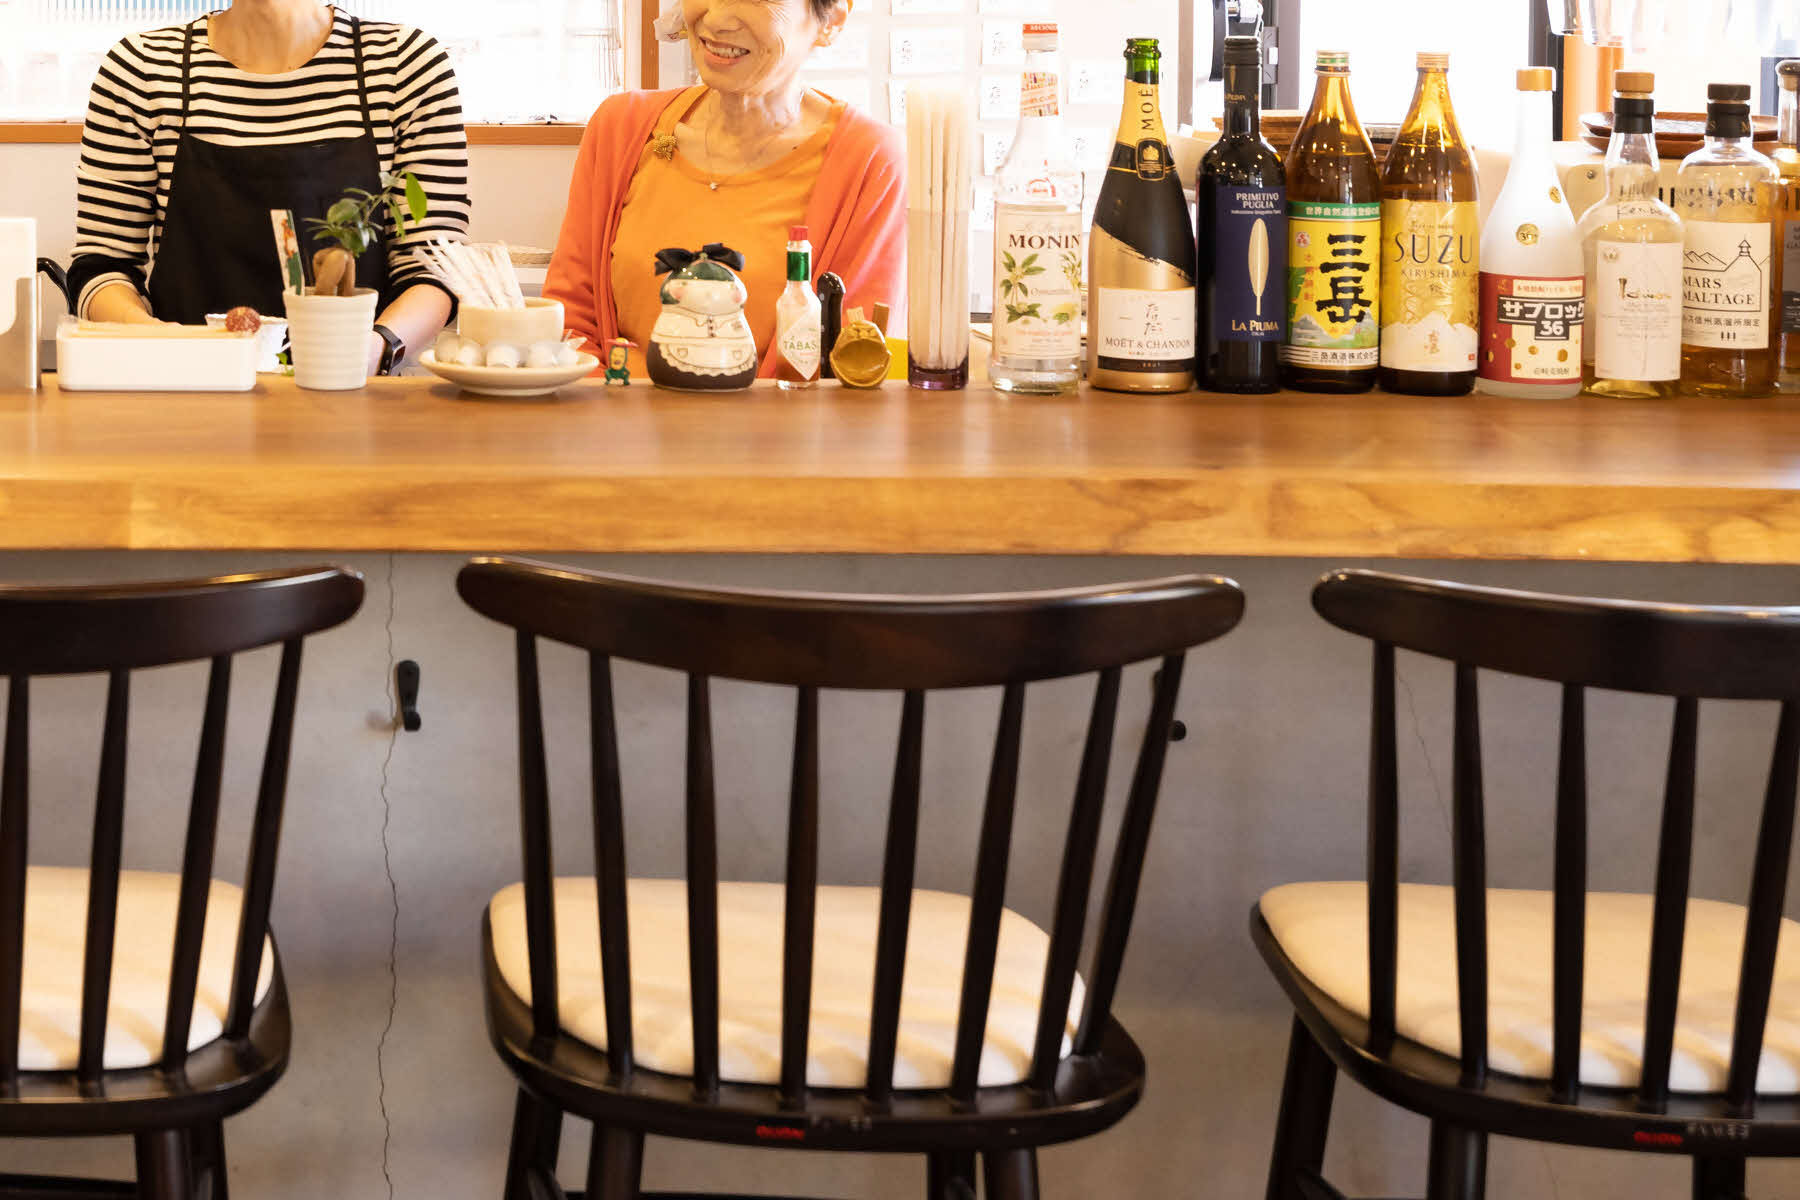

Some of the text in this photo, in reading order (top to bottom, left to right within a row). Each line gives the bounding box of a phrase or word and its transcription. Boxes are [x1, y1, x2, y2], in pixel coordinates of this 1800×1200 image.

[1235, 192, 1280, 201] PRIMITIVO
[1242, 200, 1275, 209] PUGLIA
[1008, 233, 1081, 249] MONIN
[1393, 232, 1473, 264] SUZU
[1315, 233, 1372, 324] 三岳
[1401, 266, 1467, 279] KIRISHIMA
[1682, 276, 1722, 289] MARS
[1231, 319, 1248, 331] LA
[1539, 320, 1565, 337] 36
